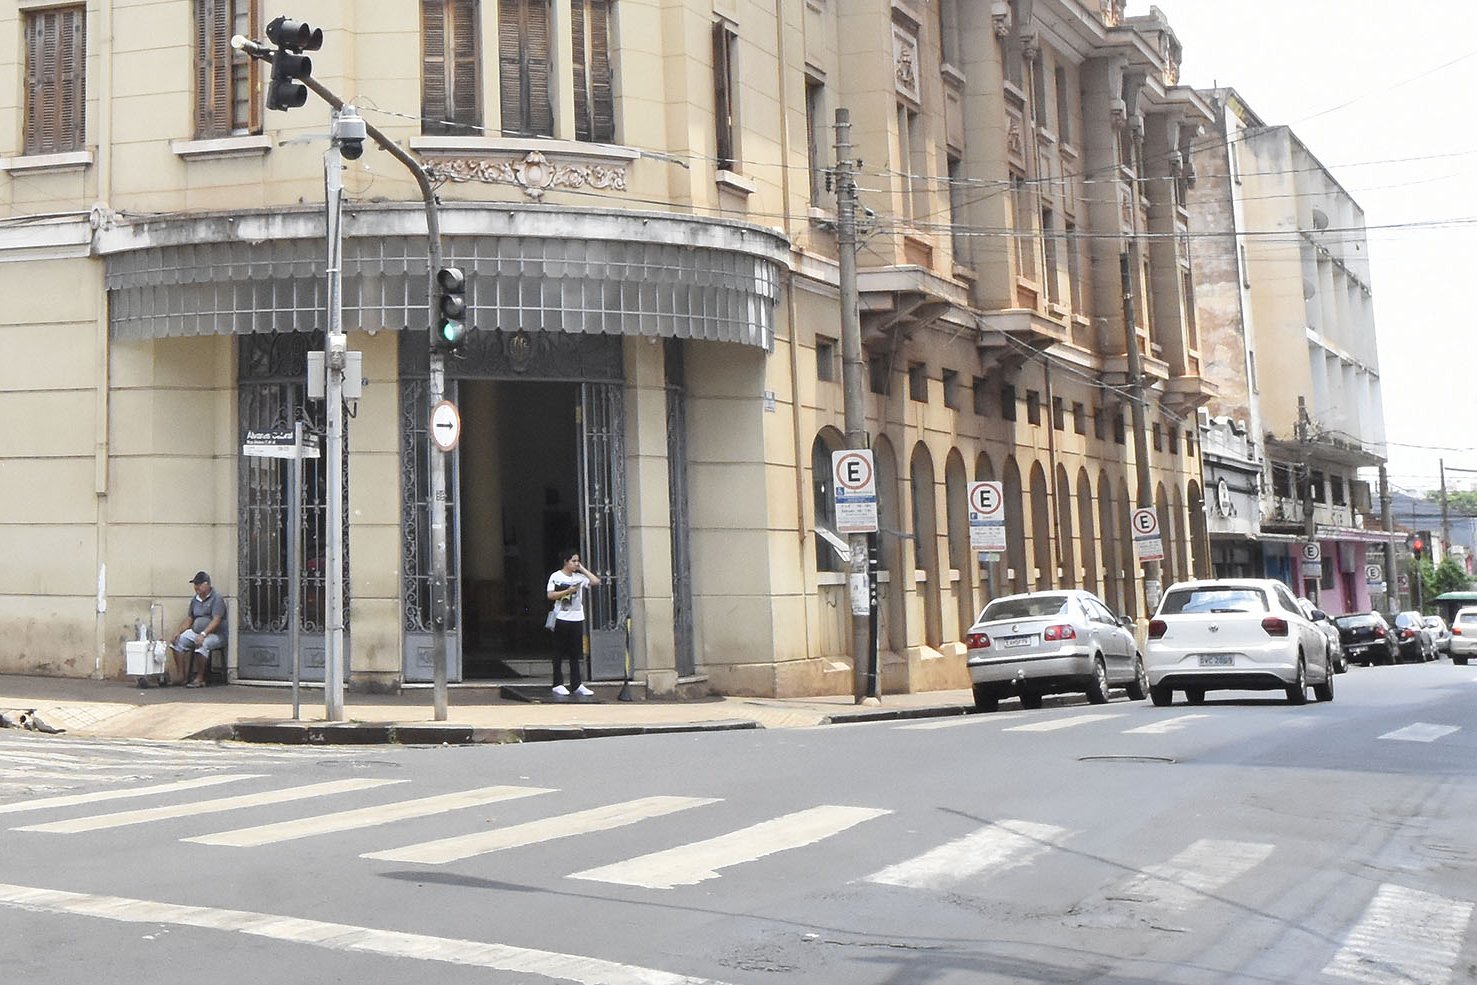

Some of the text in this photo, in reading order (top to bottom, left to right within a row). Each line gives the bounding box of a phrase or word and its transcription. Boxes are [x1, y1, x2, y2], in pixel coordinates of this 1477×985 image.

[847, 461, 861, 482] E
[980, 490, 992, 507] E
[1140, 515, 1150, 529] E
[1307, 546, 1314, 556] E
[1370, 568, 1377, 577] E
